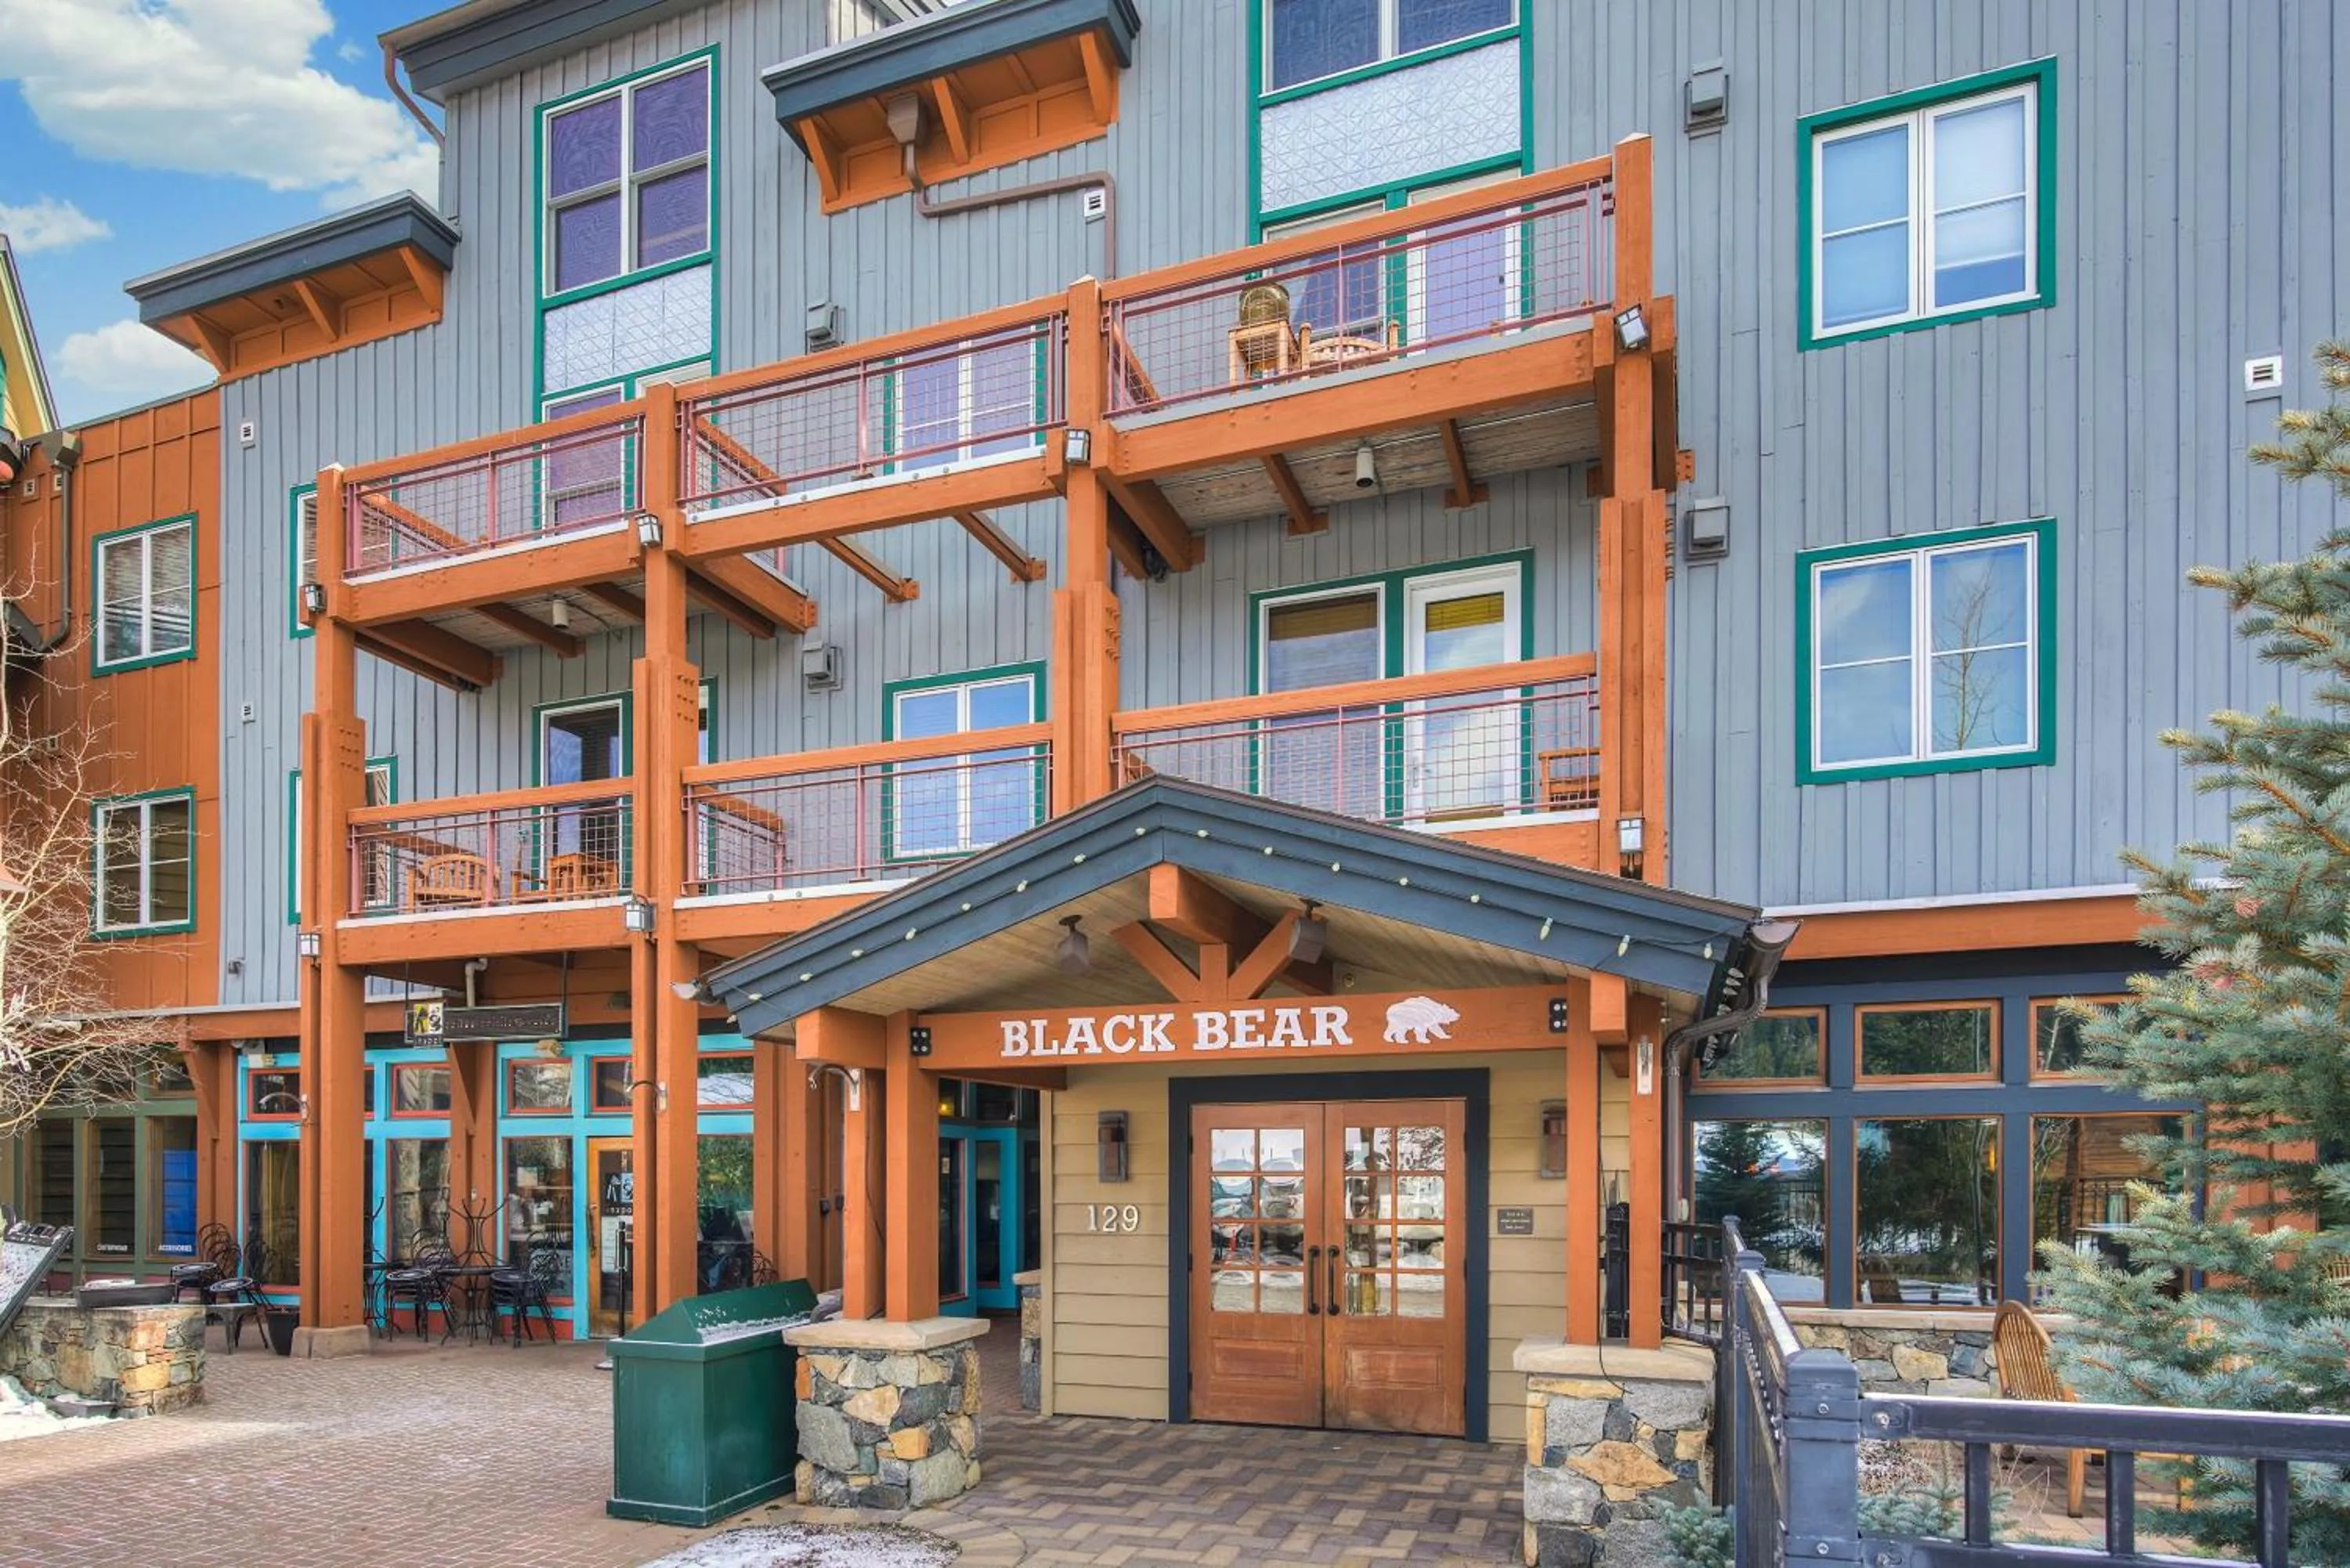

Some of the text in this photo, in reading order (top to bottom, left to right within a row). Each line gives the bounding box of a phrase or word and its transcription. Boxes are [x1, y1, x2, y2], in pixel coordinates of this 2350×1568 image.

[1000, 1006, 1354, 1057] BLACK BEAR
[1086, 1205, 1138, 1232] 129
